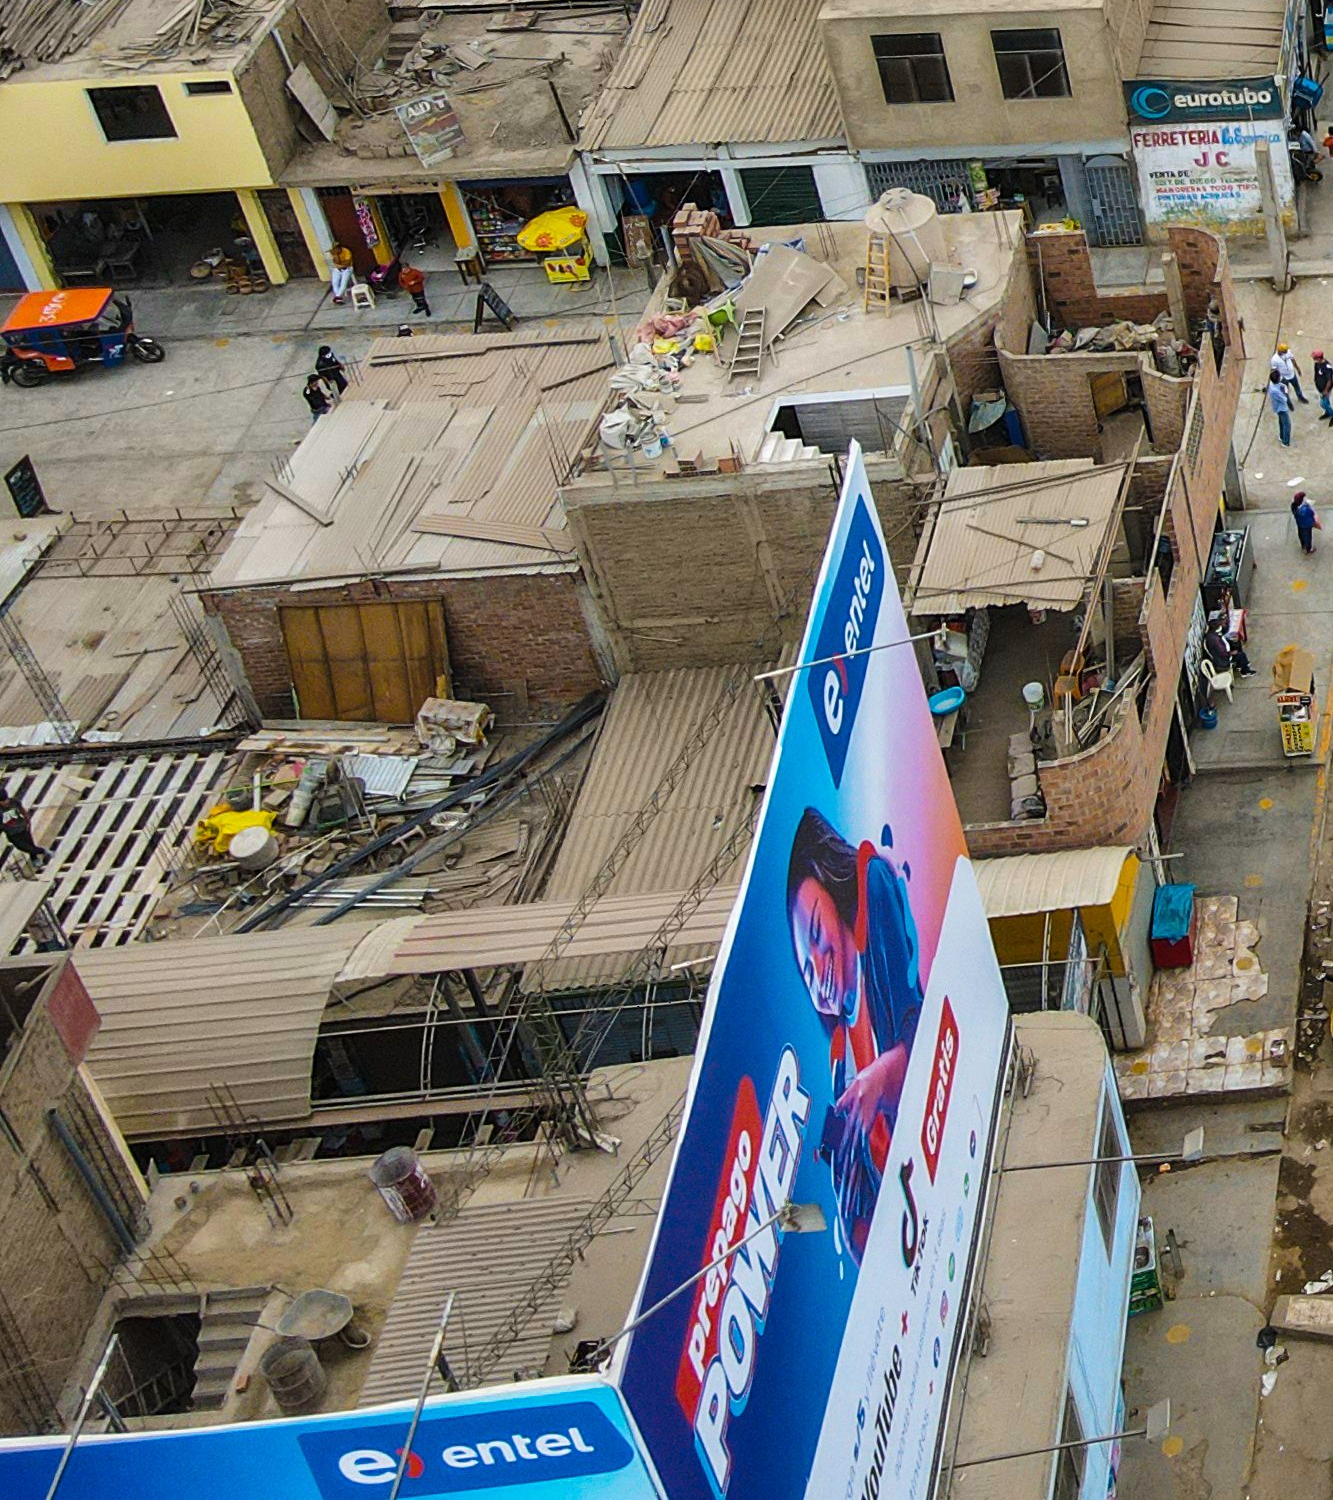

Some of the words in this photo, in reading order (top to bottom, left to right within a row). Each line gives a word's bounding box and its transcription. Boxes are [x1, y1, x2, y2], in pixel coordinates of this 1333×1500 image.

[1133, 130, 1220, 148] FERRETERIA
[1174, 88, 1272, 108] eurotubo
[845, 540, 875, 660] entel
[926, 1026, 954, 1156] Gratis
[689, 1129, 752, 1382] prepago
[695, 1043, 811, 1491] POWER
[442, 1427, 594, 1468] entel
